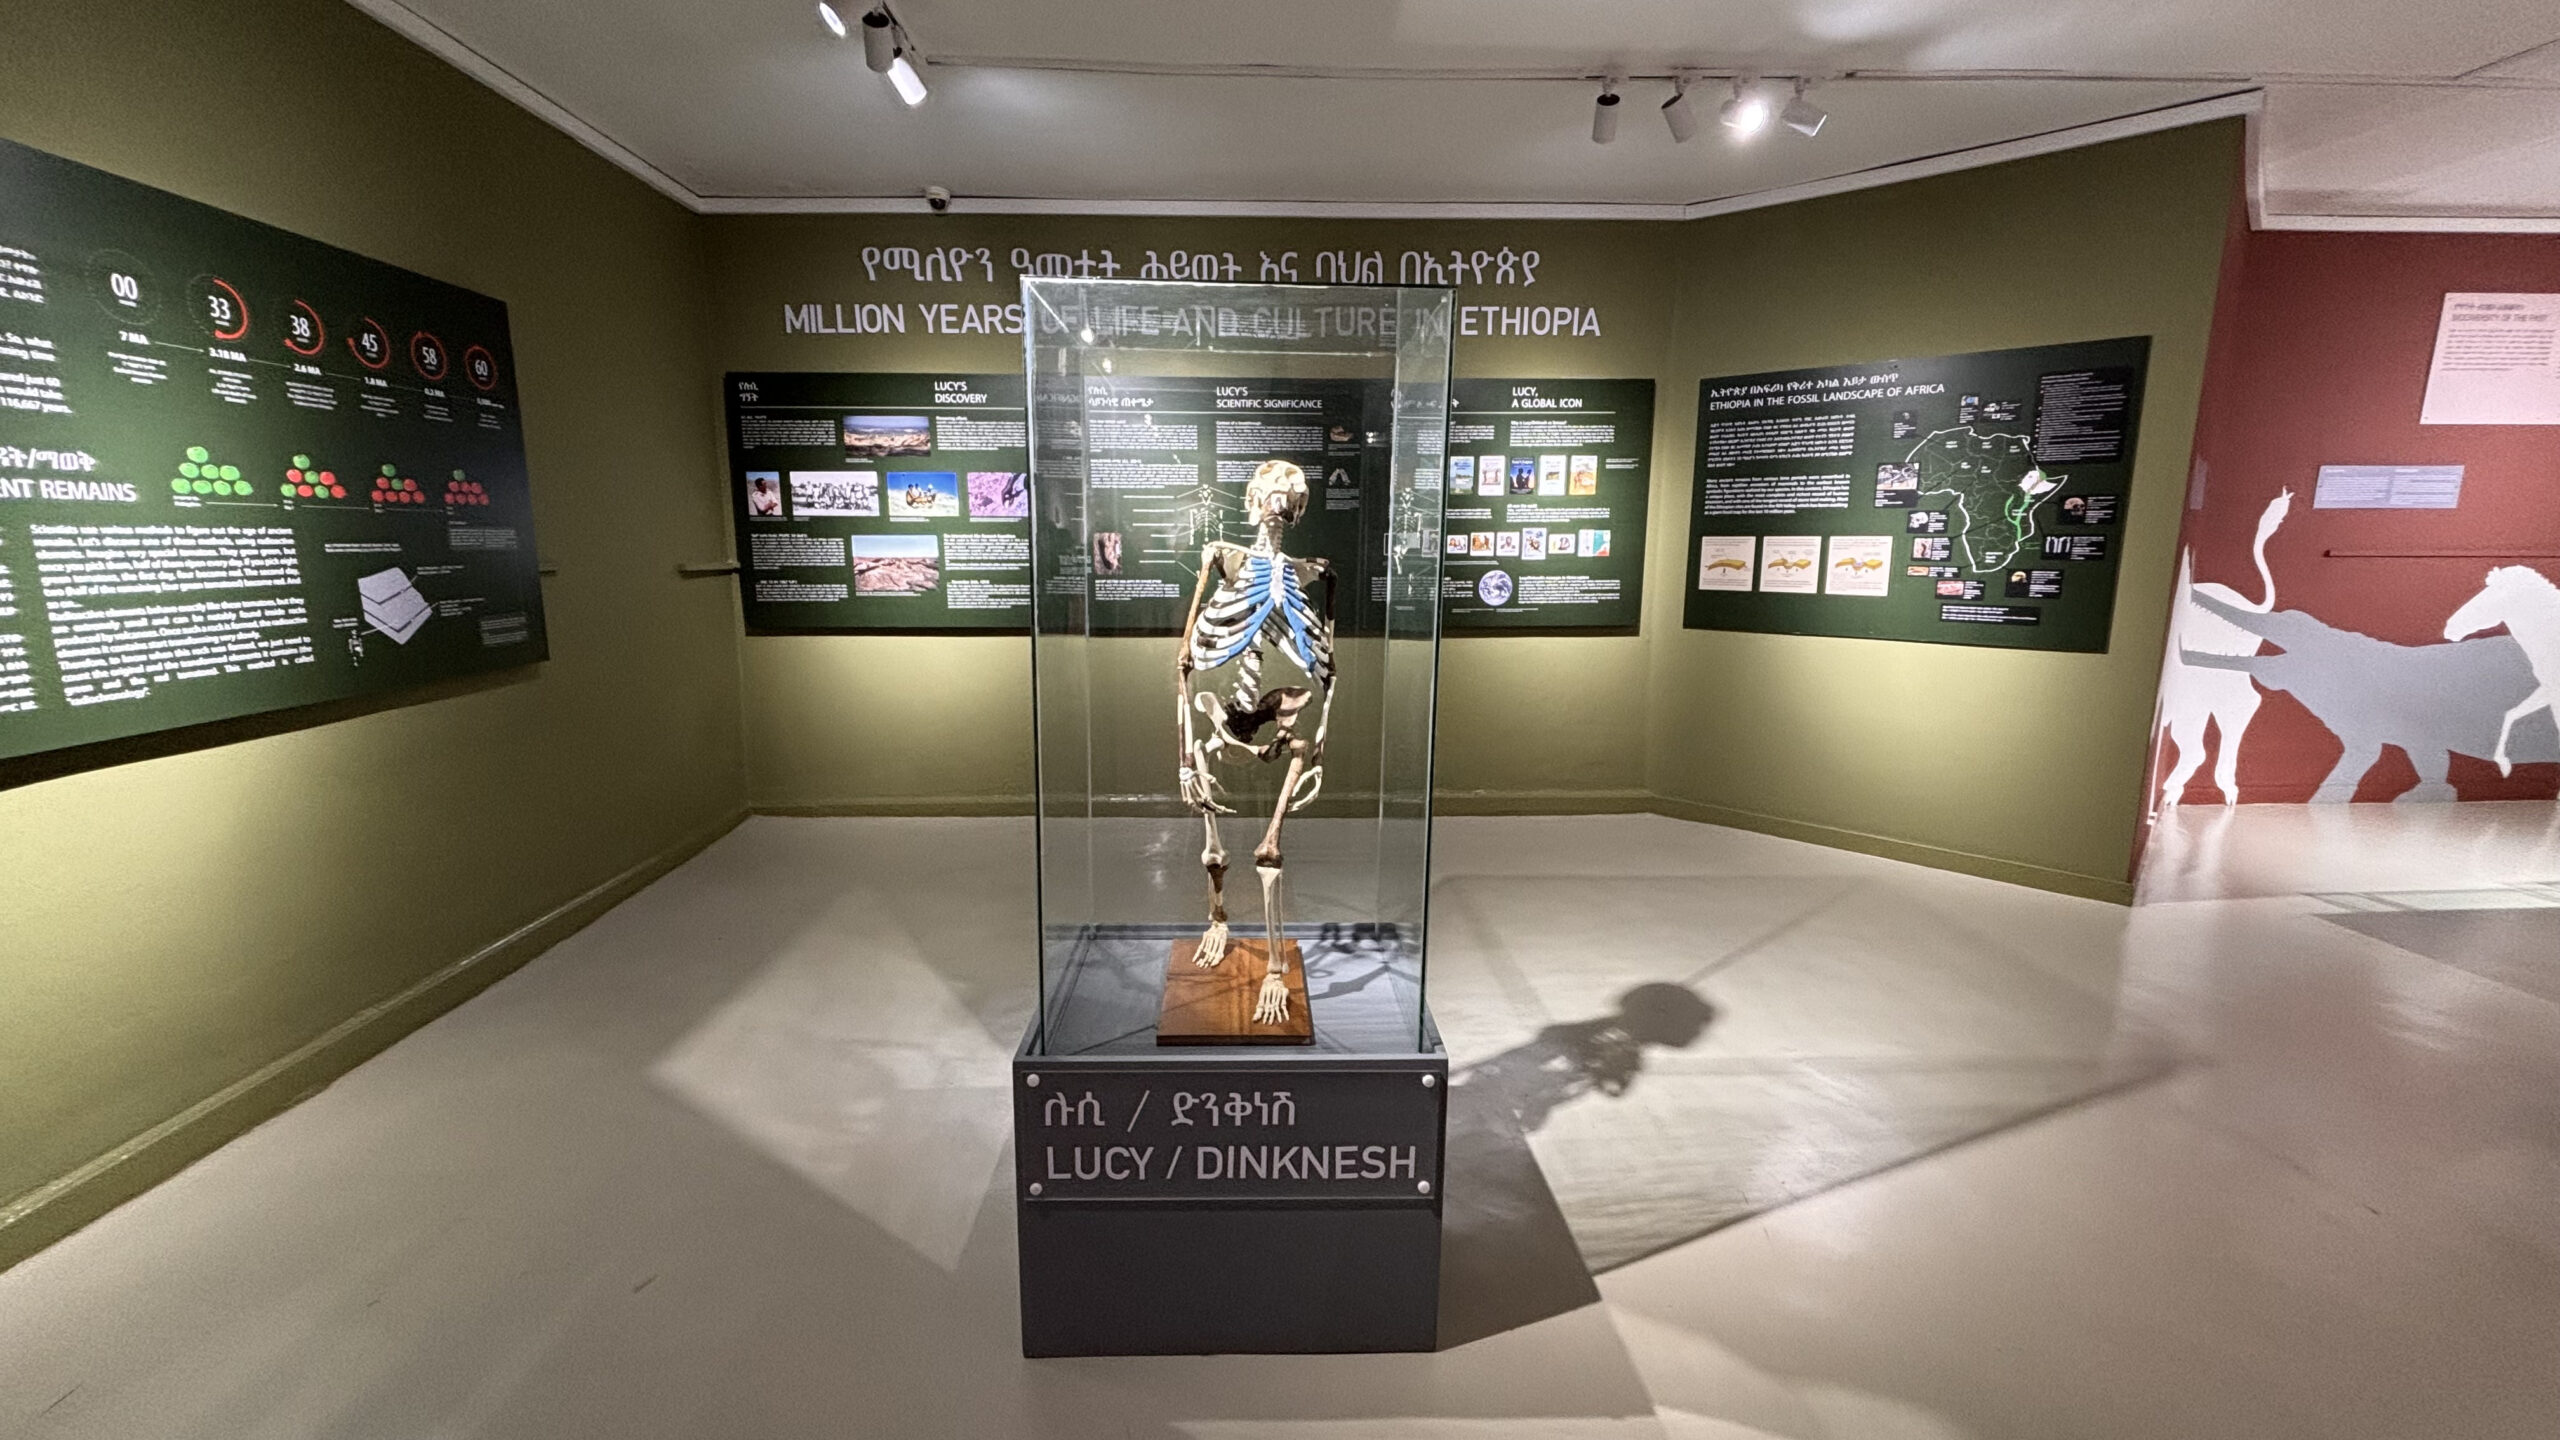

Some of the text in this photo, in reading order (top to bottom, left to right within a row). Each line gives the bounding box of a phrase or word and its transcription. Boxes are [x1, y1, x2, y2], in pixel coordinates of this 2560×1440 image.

[862, 247, 994, 282] የሚሊዮን
[1259, 250, 1299, 282] እና
[1315, 250, 1384, 283] ባህል
[1400, 246, 1541, 287] በኢትዮጵያ
[110, 273, 138, 299] 00
[208, 296, 231, 319] 33
[290, 315, 311, 337] 38
[784, 304, 905, 334] MILLION
[918, 304, 1024, 334] YEARS
[1040, 305, 1080, 335] OF
[1094, 305, 1160, 336] LIFE
[1172, 305, 1237, 337] AND
[1252, 306, 1397, 338] CULTURE
[1460, 306, 1601, 337] ETHIOPIA
[129, 333, 150, 345] MA
[362, 333, 378, 352] 45
[422, 347, 438, 365] 58
[474, 360, 488, 376] 60
[935, 381, 967, 392] LUCY'S
[1216, 386, 1248, 397] LUCY'S
[1512, 387, 1539, 398] LUCY,
[935, 393, 987, 404] DISCOVERY
[1216, 398, 1323, 409] SCIENTIFIC SIGNIFICANCE
[1511, 398, 1583, 409] A GLOBAL ICON
[1710, 383, 1945, 411] ETHIOPIA IN THE FOSSIL LANDSCAPE OF AFRICA
[0, 478, 137, 502] NT REMAINS
[1044, 1090, 1296, 1133] ሉሲ / ድንቅነሽ
[1046, 1145, 1417, 1180] LUCY / DINKNESH
